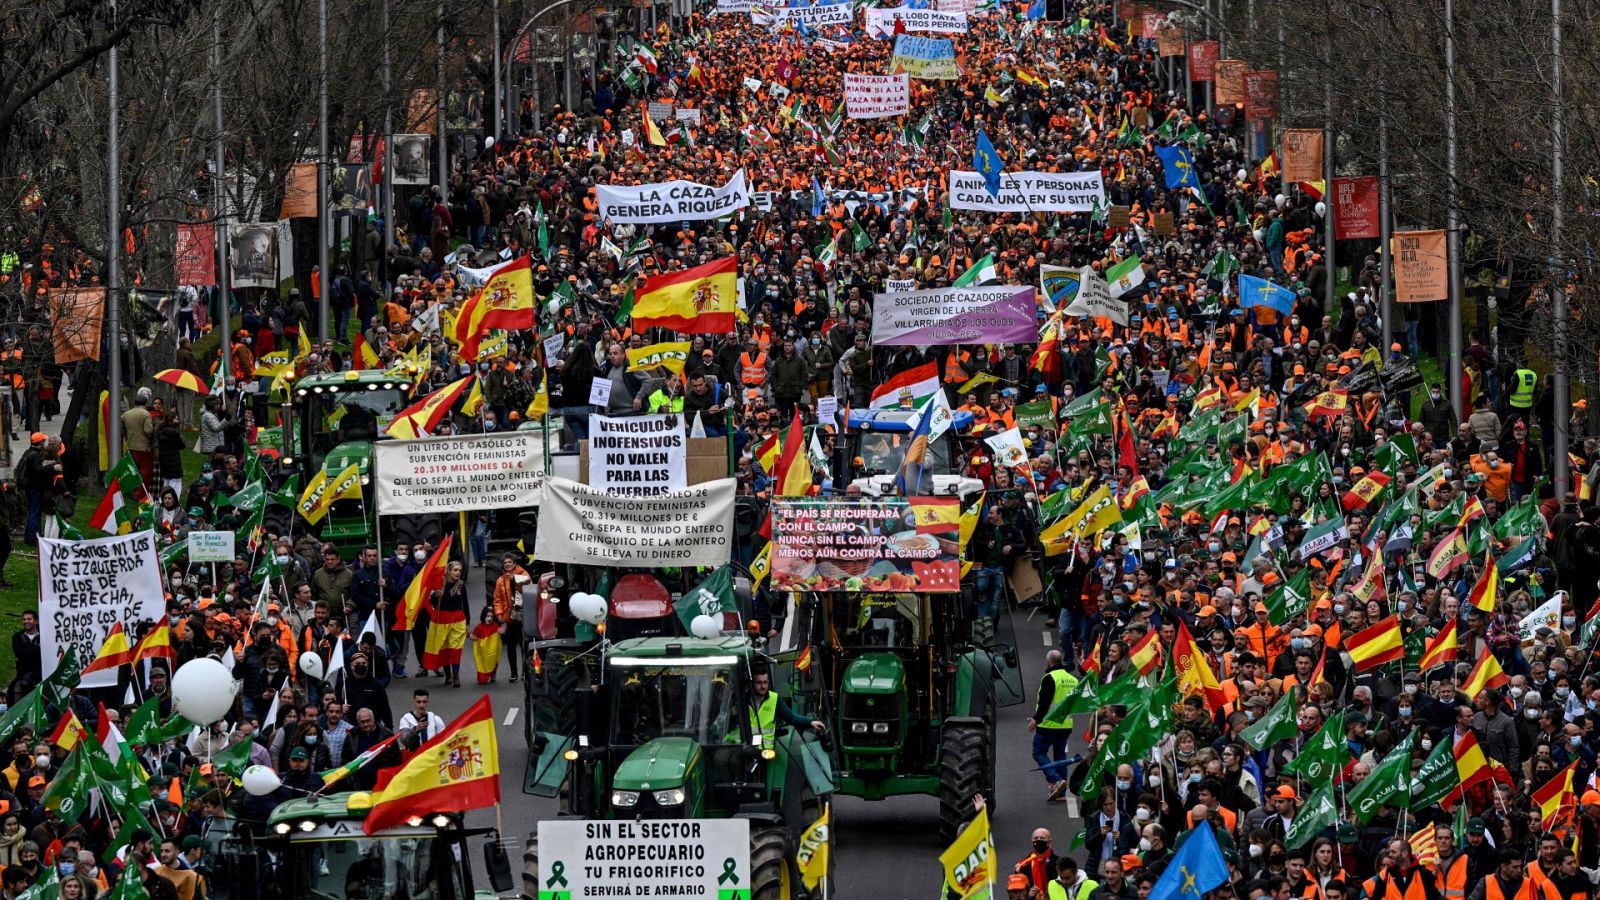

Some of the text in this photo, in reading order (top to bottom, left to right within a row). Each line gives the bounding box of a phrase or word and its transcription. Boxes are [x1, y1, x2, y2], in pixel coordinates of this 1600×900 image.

[788, 6, 839, 17] ASTURIAS
[804, 16, 819, 24] LA
[820, 13, 849, 23] CAZA
[932, 21, 966, 29] PERROS
[955, 180, 1099, 191] ANIMLES Y PERSONAS
[640, 187, 715, 202] LA CAZA
[957, 193, 1099, 204] CADA UNO EN SU SITIO
[606, 203, 674, 217] GENERA
[678, 191, 741, 213] RIQUEZA
[895, 293, 1014, 306] SOCIEDAD DE CAZADORES
[910, 307, 940, 316] VIRGEN
[942, 306, 953, 315] DE
[955, 306, 966, 315] LA
[968, 306, 998, 314] SIERRA
[895, 318, 1014, 329] VILLARRUBIA DE LOS OJOS
[600, 420, 675, 433] VEHÍCULOS
[424, 443, 449, 452] LITRO
[452, 442, 463, 450] DE
[466, 439, 512, 449] GASÓLEO
[516, 439, 527, 447] 2€
[594, 435, 681, 449] INOFENSIVOS
[410, 450, 526, 463] SUBVENCIÓN FEMINISTAS
[607, 453, 668, 465] NO VALEN
[414, 466, 447, 474] 20.319
[451, 463, 498, 472] MILLONES
[394, 470, 544, 486] QUE LO SEPA EL MUNDO ENTERO
[607, 470, 669, 482] PARA LAS
[406, 486, 467, 496] CHIRINGUITO
[486, 484, 496, 492] LA
[572, 486, 587, 495] UN
[696, 489, 708, 497] 2€
[424, 499, 434, 507] SE
[437, 497, 463, 506] LLEVA
[481, 495, 517, 503] DINERO
[573, 498, 706, 510] SUBVENCIÓN FEMINISTAS
[582, 511, 698, 523] 20.319 MILLONES DE €
[796, 508, 818, 518] PAÍS
[820, 510, 832, 518] SE
[834, 508, 900, 518] RECUPERARÁ
[582, 522, 724, 534] LO SEPA EL MUNDO ENTERO
[779, 523, 856, 531] CON EL CAMPO
[569, 533, 726, 546] CHIRINGUITO DE LA MONTERO
[779, 536, 896, 545] NUNCA SIN EL CAMPO Y
[112, 542, 127, 557] NI
[587, 547, 691, 559] SE LLEVA TU DINERO
[779, 547, 942, 558] MENOS AÚN CONTRA EL CAMPO"
[50, 555, 144, 578] DE IZQUIERDA
[53, 575, 117, 593] NI LOS DE
[59, 587, 133, 608] DERECHA,
[54, 601, 143, 629] SOMOS LOS DE
[55, 628, 96, 643] ABAJO,
[72, 641, 95, 655] POR
[1419, 752, 1453, 780] ASAJA
[586, 823, 701, 839] SIN EL SECTOR
[585, 845, 705, 861] AGROPECUARIO
[585, 863, 705, 878] TU FRIGORÍFICO
[584, 883, 705, 896] SERVIRÁ DE ARMARIO
